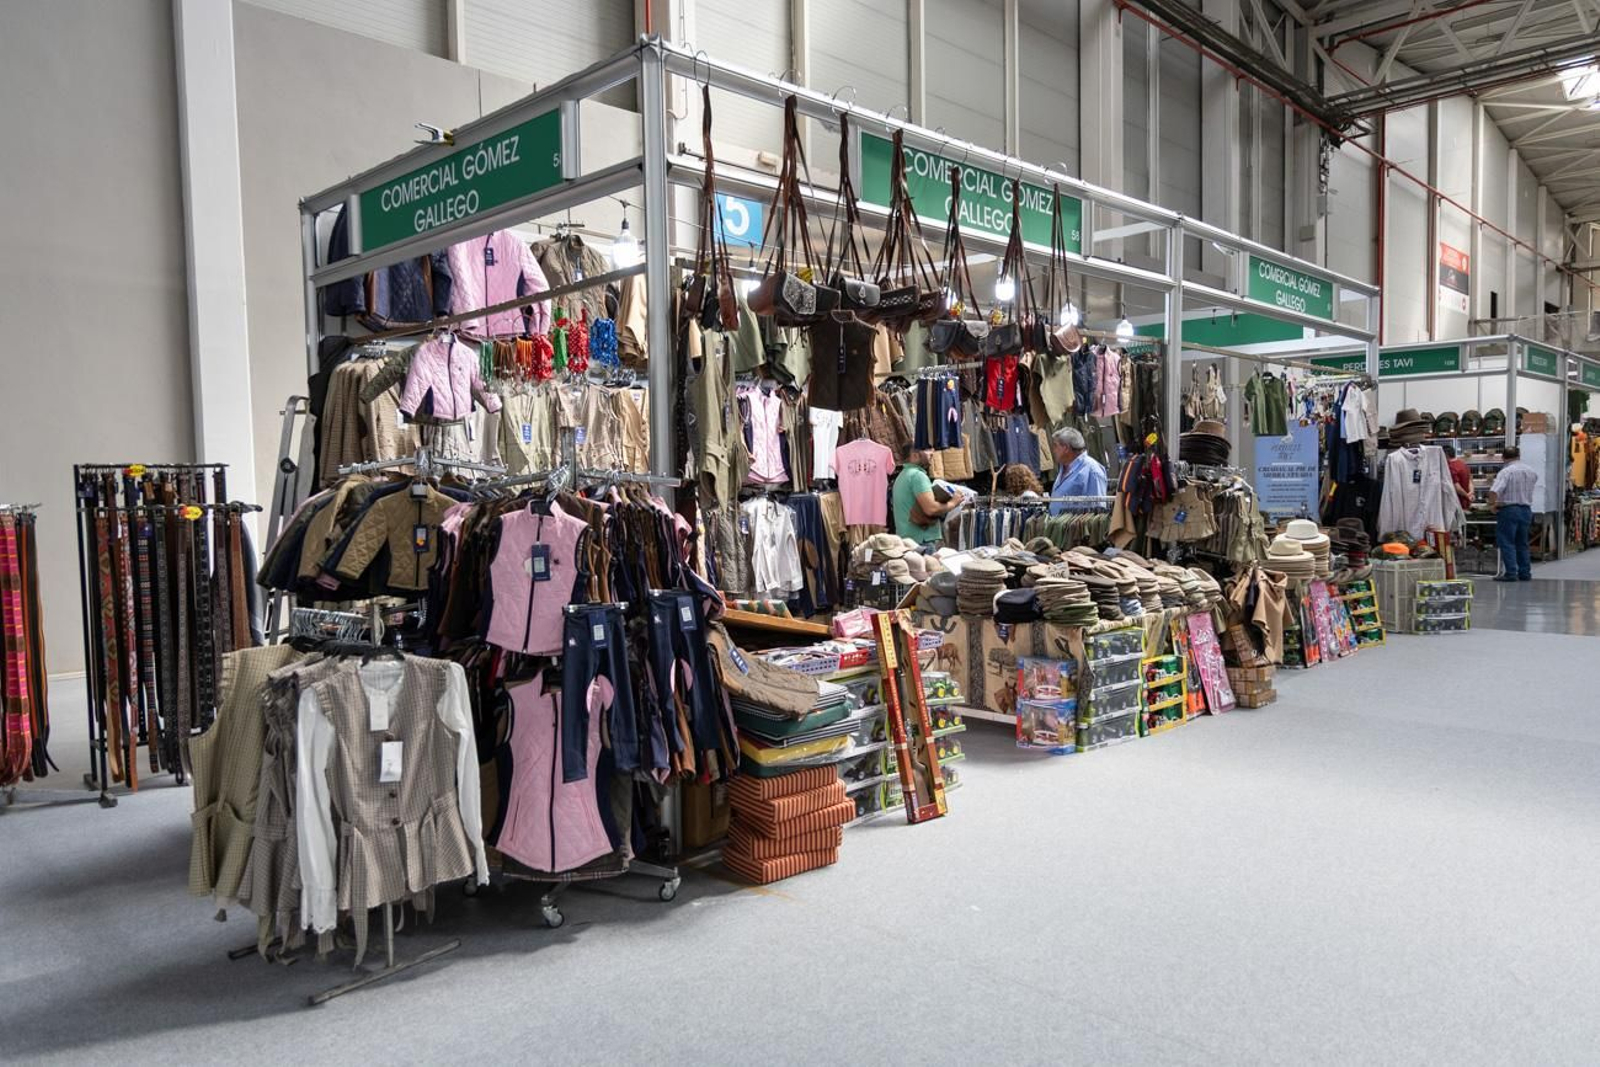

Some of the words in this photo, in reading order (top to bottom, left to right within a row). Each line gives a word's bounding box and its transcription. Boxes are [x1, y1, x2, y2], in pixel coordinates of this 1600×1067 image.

[381, 162, 459, 212] COMERCIAL
[462, 136, 520, 180] GÓMEZ
[414, 189, 479, 232] GALLEGO
[725, 196, 750, 236] 5
[1259, 262, 1297, 290] COMERCIAL
[1298, 276, 1321, 298] GÓMEZ
[1276, 290, 1306, 313] GALLEGO
[1343, 359, 1391, 371] PERDES
[1393, 358, 1414, 369] TAVI
